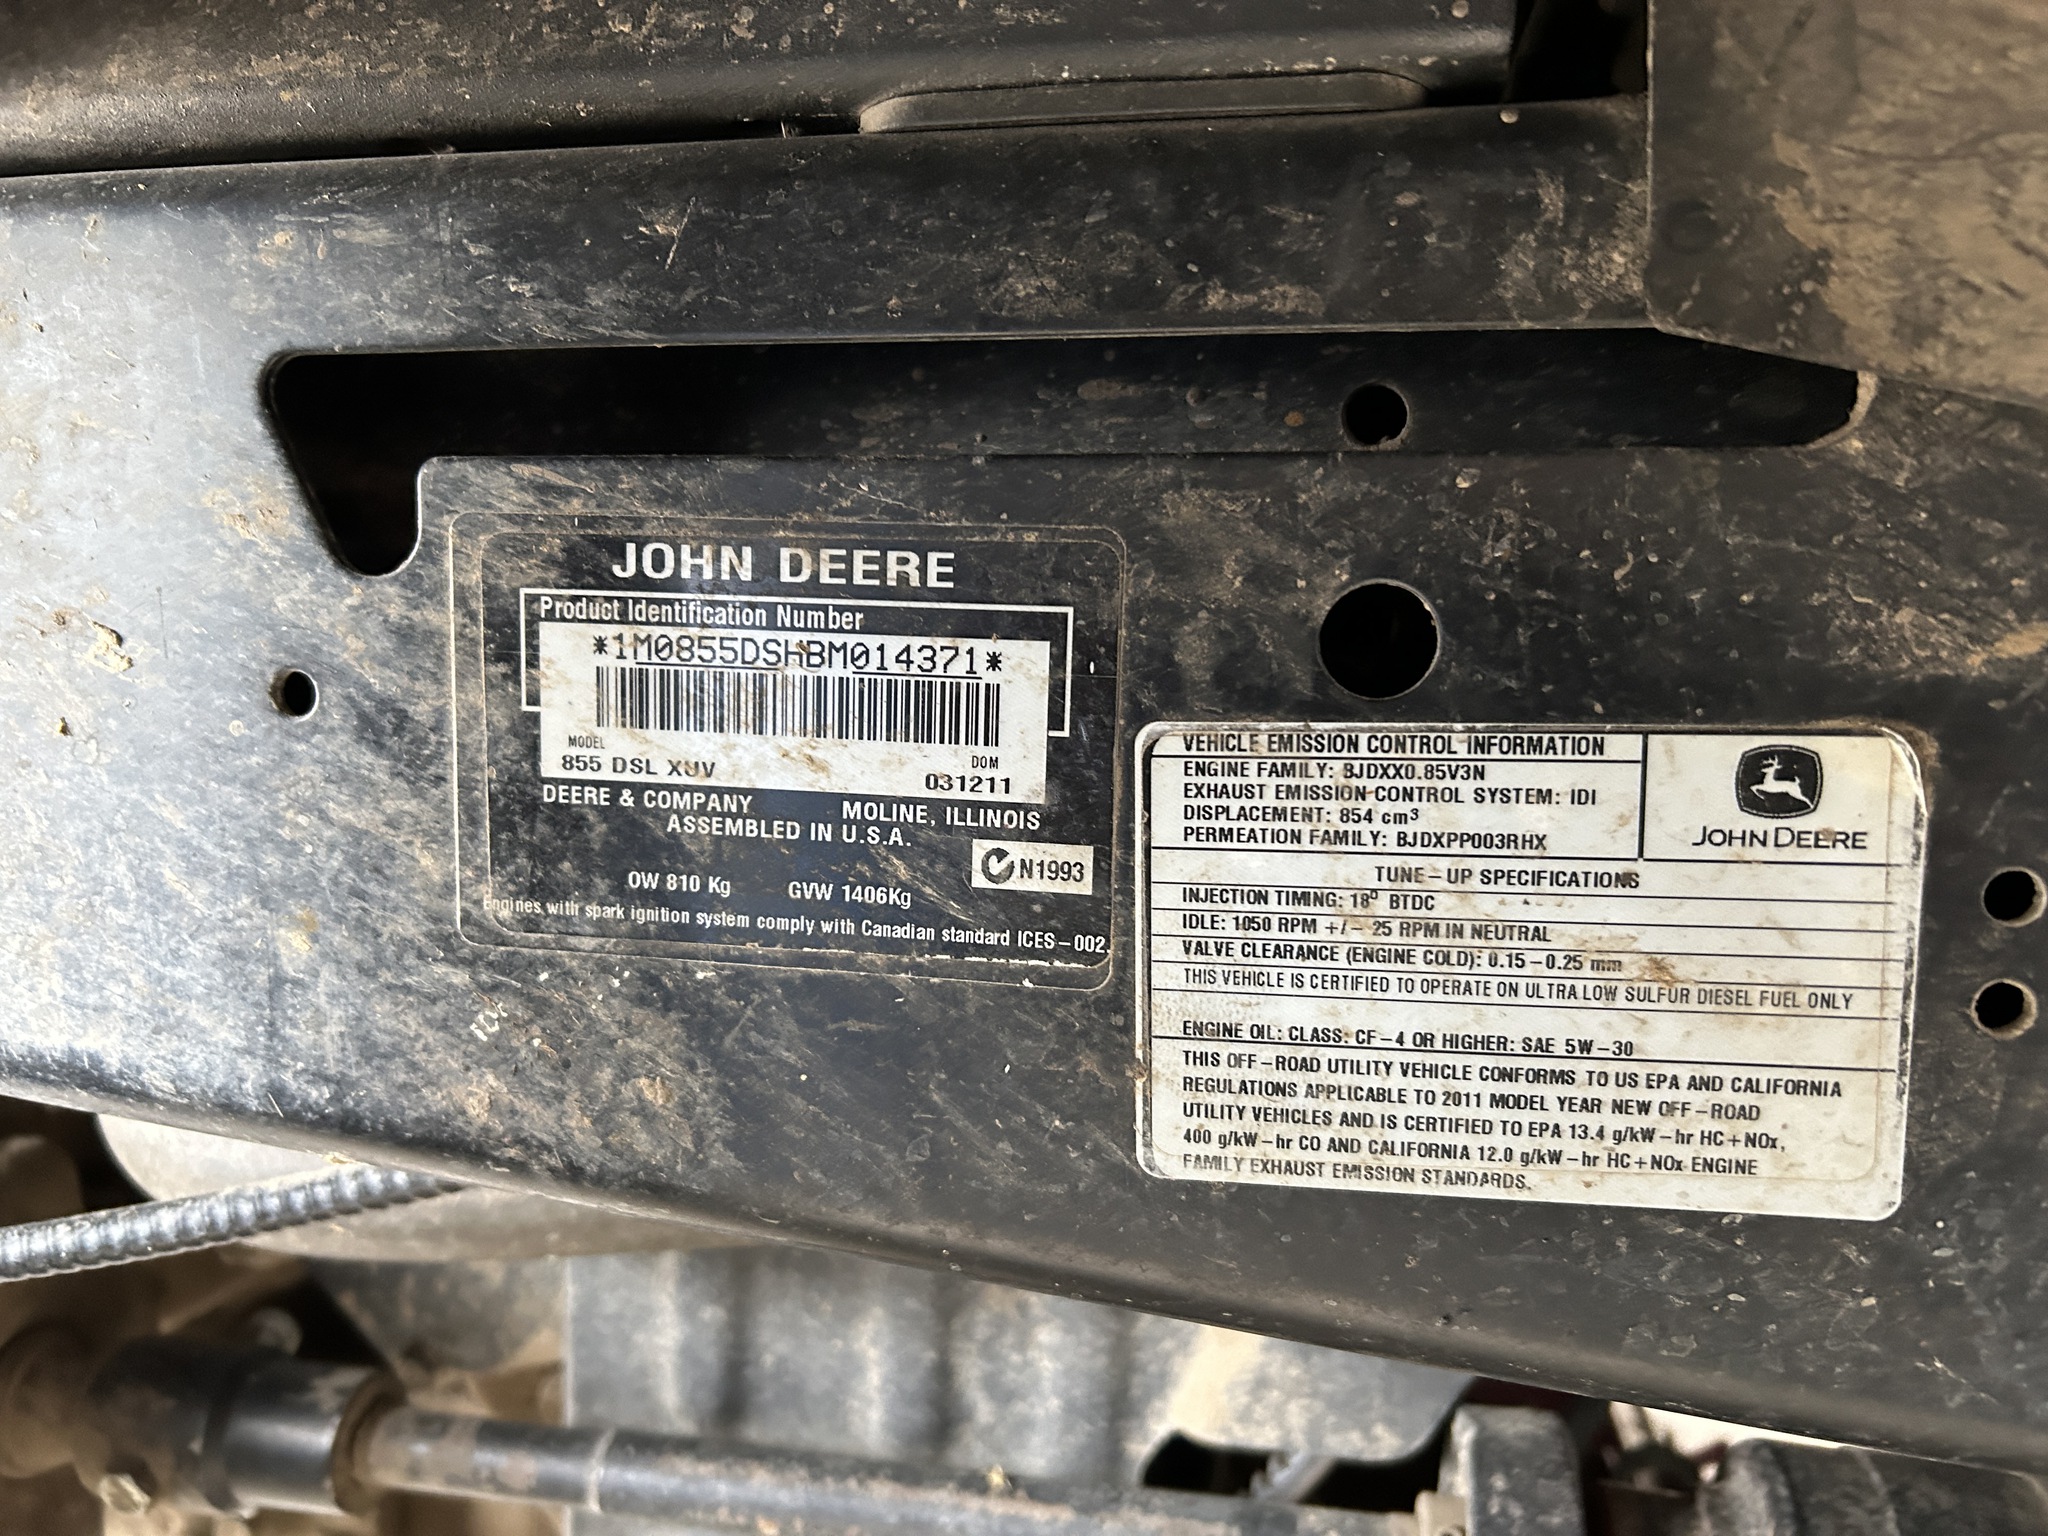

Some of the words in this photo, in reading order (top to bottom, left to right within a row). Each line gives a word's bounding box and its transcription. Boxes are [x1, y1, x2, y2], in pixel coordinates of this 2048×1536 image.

[612, 542, 752, 581] JOHN
[780, 547, 955, 588] DEERE
[540, 596, 620, 621] Product
[629, 599, 766, 627] Identification
[777, 604, 863, 630] Number
[568, 735, 606, 749] MODEL
[1183, 733, 1259, 752] VEHICLE
[1267, 734, 1359, 753] EMISSION
[1367, 734, 1457, 754] CONTROL
[1467, 735, 1605, 756] INFORMATION
[561, 755, 602, 771] 855
[612, 757, 658, 775] DSL
[668, 759, 716, 778] XUV
[971, 755, 999, 769] DOM
[1183, 760, 1250, 777] ENGINE
[1257, 761, 1334, 779] FAMILY:
[925, 773, 1010, 794] 031211
[1183, 782, 1266, 800] EXHAUST
[1275, 784, 1366, 801] EMISSION
[1374, 786, 1464, 803] CONTROL
[1473, 787, 1560, 805] SYSTEM:
[1570, 789, 1596, 805] IDI
[543, 784, 610, 806] DEERE
[619, 789, 635, 807] &
[643, 790, 753, 814] COMPANY
[842, 801, 936, 827] MOLINE,
[946, 809, 1040, 830] ILLINOIS
[1183, 805, 1331, 823] DISPLACEMENT:
[1339, 807, 1373, 824] 854
[667, 814, 800, 840] ASSEMBLED
[810, 823, 832, 841] IN
[842, 824, 911, 846] U.S.A.
[1183, 826, 1301, 845] PERMEATION
[1309, 829, 1387, 847] FAMILY:
[1397, 831, 1547, 850] BJDXPP003RHX
[1692, 826, 1767, 848] JOHN
[1774, 827, 1868, 849] DEERE
[1020, 858, 1084, 882] N1993
[1480, 869, 1640, 888] SPECIFICATIONS
[666, 873, 700, 892] 810
[708, 876, 731, 898] Kg
[788, 881, 833, 901] GVW
[842, 885, 911, 908] 1406Kg
[1182, 887, 1268, 905] INJECTION
[1275, 890, 1343, 908] TIMING:
[1389, 894, 1435, 910] BTDC
[483, 895, 541, 915] Engines
[546, 899, 579, 916] with
[585, 903, 625, 920] spark
[630, 905, 689, 925] ignition
[696, 911, 749, 928] system
[757, 914, 815, 935] comply
[820, 917, 855, 935] with
[861, 919, 935, 941] Canadian
[941, 926, 1010, 947] standard
[1182, 913, 1226, 930] IDLE:
[1233, 915, 1271, 932] 1050
[1278, 917, 1317, 934] RPM
[1372, 920, 1392, 936] 25
[1399, 921, 1439, 938] RPM
[1446, 922, 1464, 939] IN
[1470, 924, 1551, 942] NEUTRAL
[1182, 940, 1234, 957] VALVE
[1241, 942, 1339, 961] CLEARANCE
[1346, 945, 1416, 965] (ENGINE
[1423, 949, 1482, 970] COLD):
[1590, 958, 1622, 972] mm
[1184, 968, 1216, 985] THIS
[1222, 970, 1284, 987] VEHICLE
[1290, 973, 1304, 988] IS
[1310, 974, 1389, 992] CERTIFIED
[1396, 977, 1415, 993] TO
[1421, 978, 1491, 997] OPERATE
[1497, 981, 1518, 998] ON
[1526, 983, 1577, 1000] ULTRA
[1583, 985, 1618, 1001] LOW
[1625, 985, 1690, 1004] SULFUR
[1697, 988, 1752, 1006] DIESEL
[1759, 991, 1801, 1008] FUEL
[1808, 992, 1853, 1010] ONLY
[1183, 1020, 1243, 1039] ENGINE
[1250, 1024, 1282, 1040] OIL:
[1412, 1032, 1435, 1048] OR
[1442, 1033, 1515, 1052] HIGHER:
[1521, 1036, 1555, 1053] SAE
[1183, 1050, 1220, 1067] THIS
[1328, 1058, 1393, 1077] UTILITY
[1400, 1062, 1472, 1080] VEHICLE
[1479, 1066, 1576, 1085] CONFORMS
[1586, 1070, 1608, 1087] TO
[1615, 1072, 1638, 1088] US
[1645, 1073, 1680, 1090] EPA
[1687, 1075, 1723, 1092] AND
[1731, 1077, 1842, 1097] CALIFORNIA
[1182, 1076, 1297, 1098] REGULATIONS
[1304, 1083, 1407, 1104] APPLICABLE
[1414, 1089, 1436, 1105] TO
[1442, 1091, 1481, 1107] 2011
[1490, 1093, 1549, 1111] MODEL
[1557, 1096, 1601, 1114] YEAR
[1611, 1099, 1652, 1116] NEW
[1182, 1102, 1246, 1121] UTILITY
[1252, 1107, 1333, 1126] VEHICLES
[1339, 1112, 1374, 1128] AND
[1380, 1114, 1397, 1130] IS
[1404, 1115, 1493, 1135] CERTIFIED
[1500, 1120, 1522, 1136] TO
[1528, 1121, 1562, 1138] EPA
[1569, 1123, 1605, 1141] 13.4
[1183, 1128, 1211, 1144] 400
[1299, 1135, 1321, 1151] CO
[1327, 1137, 1361, 1154] AND
[1368, 1139, 1470, 1161] CALIFORNIA
[1477, 1146, 1513, 1163] 12.0
[1691, 1157, 1758, 1175] ENGINE
[1183, 1153, 1247, 1172] FAMILY
[1250, 1158, 1325, 1177] EXHAUST
[1332, 1163, 1415, 1183] EMISSION
[1421, 1168, 1532, 1190] STANDARDS.
